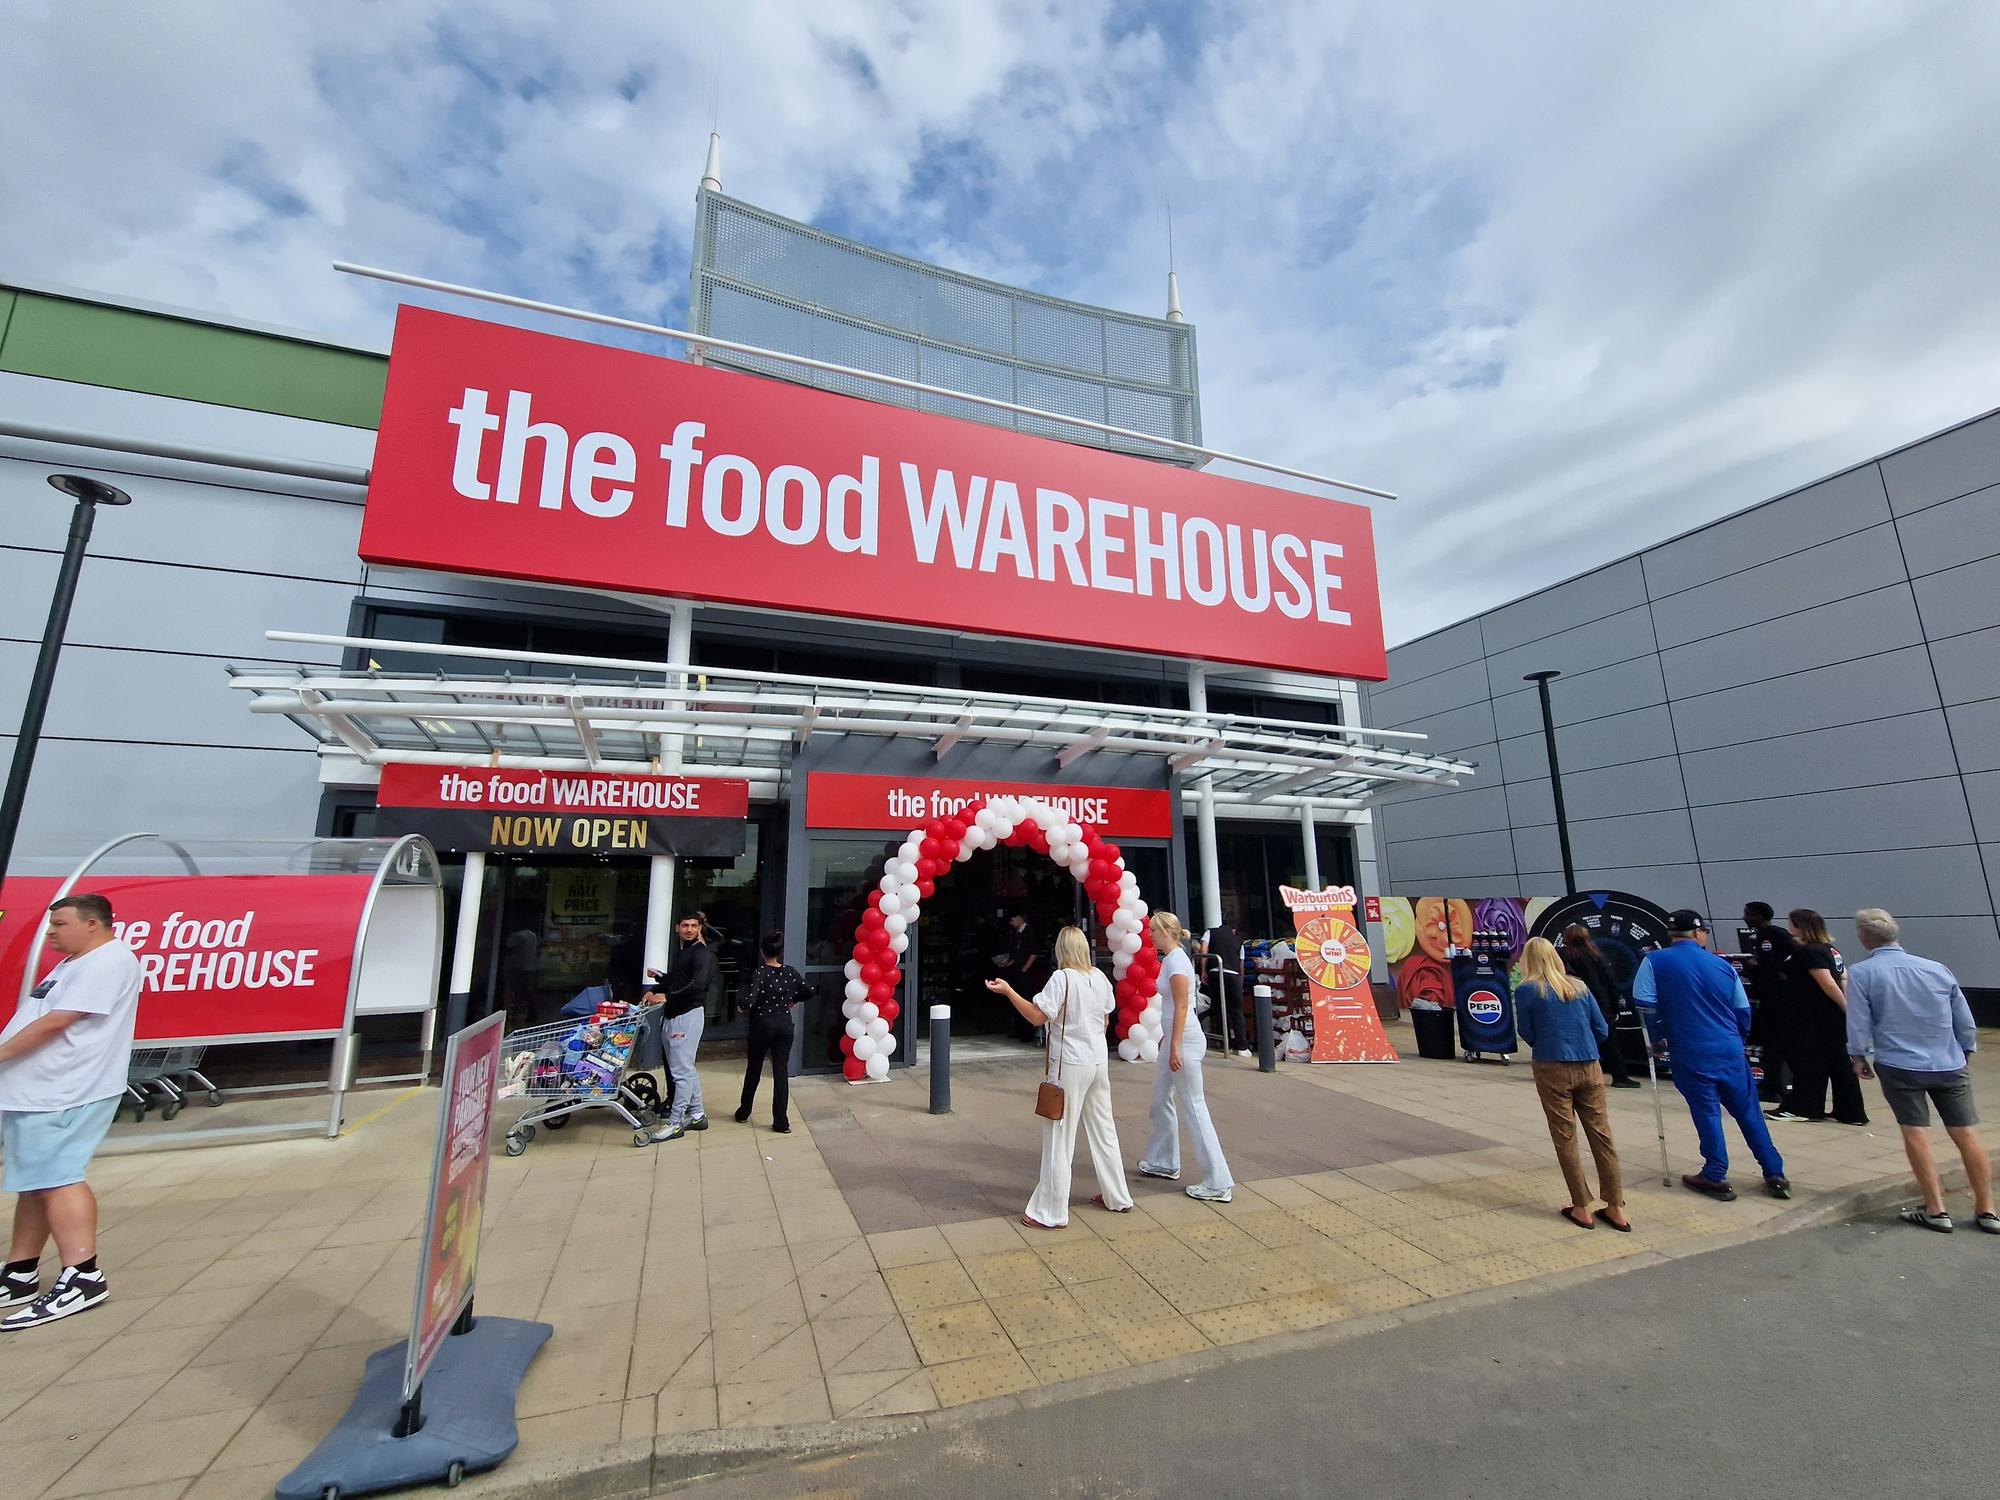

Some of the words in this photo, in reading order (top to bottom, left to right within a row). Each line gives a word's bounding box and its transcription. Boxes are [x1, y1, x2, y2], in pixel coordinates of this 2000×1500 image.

[447, 387, 638, 518] the
[660, 421, 880, 556] food
[899, 461, 1352, 626] WAREHOUSE
[439, 773, 483, 802] the
[488, 774, 547, 805] food
[552, 778, 701, 810] WAREHOUSE
[887, 788, 926, 819] the
[490, 815, 563, 847] NOW
[570, 817, 648, 849] OPEN
[1284, 888, 1354, 904] Warburtons
[159, 910, 255, 950] food
[138, 949, 319, 993] REHOUSE
[1469, 1003, 1500, 1011] PEPSI
